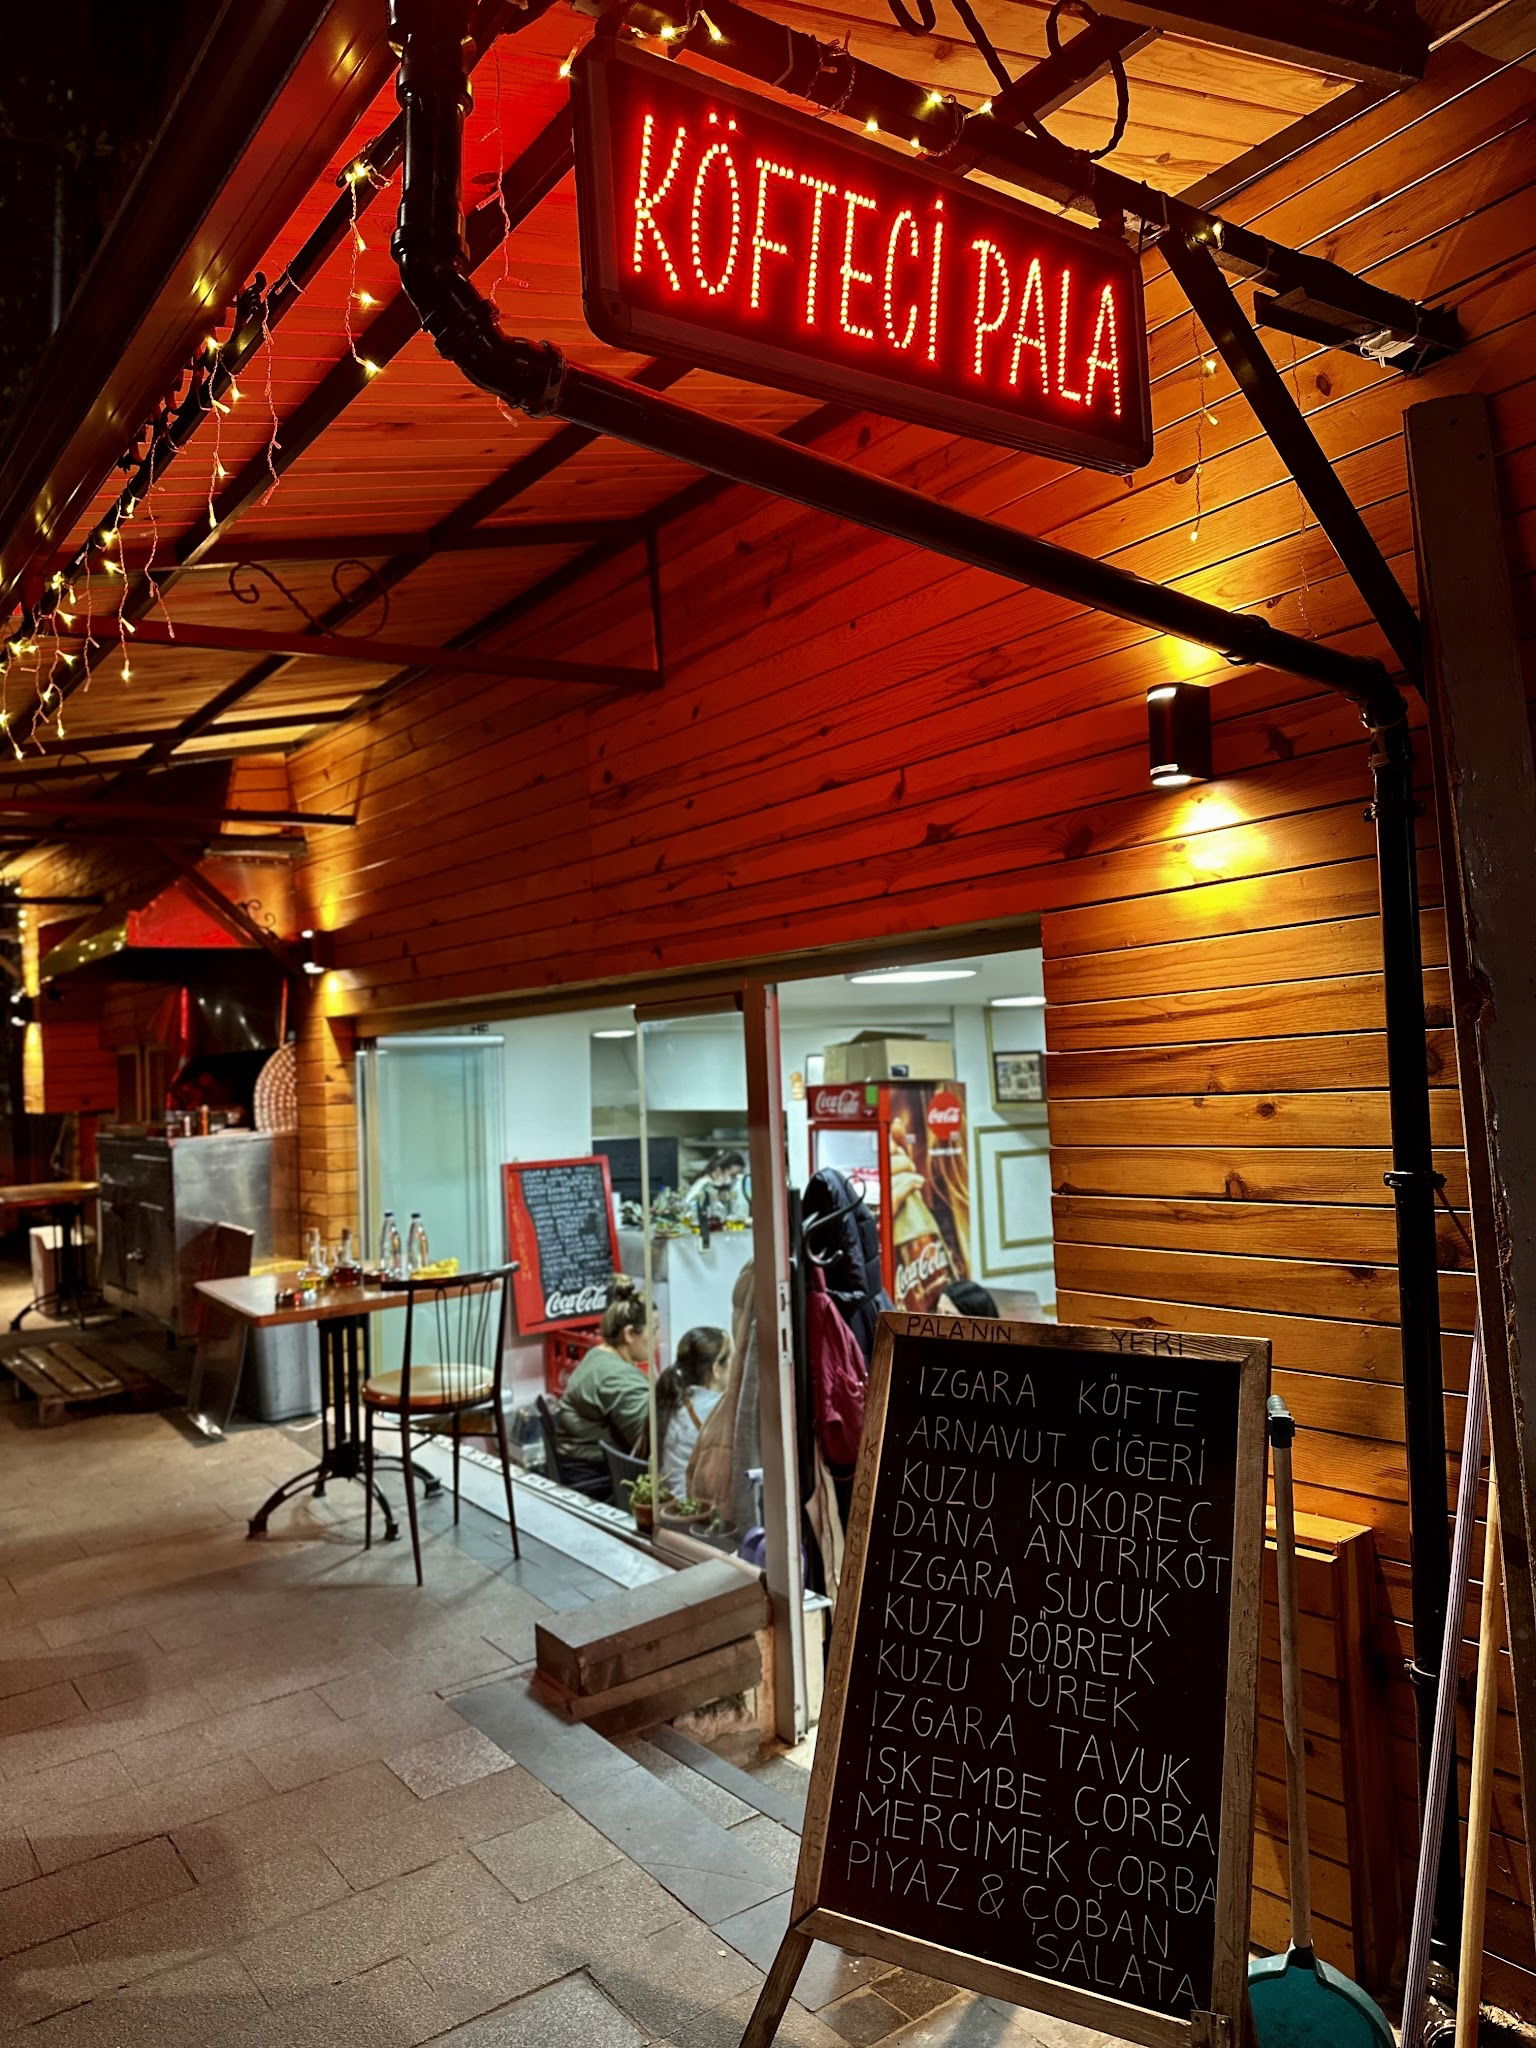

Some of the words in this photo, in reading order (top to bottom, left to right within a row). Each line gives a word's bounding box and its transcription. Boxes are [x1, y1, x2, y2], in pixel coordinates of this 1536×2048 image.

[632, 112, 945, 362] KÖFTECİ
[970, 238, 1124, 417] PALA
[920, 1366, 1036, 1408] IZGARA
[1078, 1373, 1200, 1427] KÖFTE
[901, 1459, 996, 1510] KUZU
[907, 1415, 1067, 1467] ARNAVUT
[1092, 1429, 1206, 1486] CİĞERİ
[893, 1501, 999, 1555] DANA
[889, 1548, 1017, 1604] IZGARA
[1042, 1572, 1171, 1638] SUCUK
[884, 1595, 984, 1647] KUZU
[1009, 1610, 1156, 1684] BÖBREK
[877, 1639, 971, 1693] KUZU
[1001, 1662, 1139, 1732] YÜREK
[871, 1690, 1017, 1756] IZGARA
[1049, 1723, 1192, 1804] TAVUK
[865, 1734, 1047, 1818] İŞKEMBE
[1074, 1786, 1216, 1856] ÇORBA
[854, 1791, 1070, 1883] MERCİMEK
[1087, 1846, 1218, 1915] ÇORBA
[846, 1838, 964, 1911] PİYAZ
[977, 1873, 1005, 1919] &
[1022, 1885, 1169, 1959] ÇOBAN
[1034, 1933, 1199, 2010] SALATA
